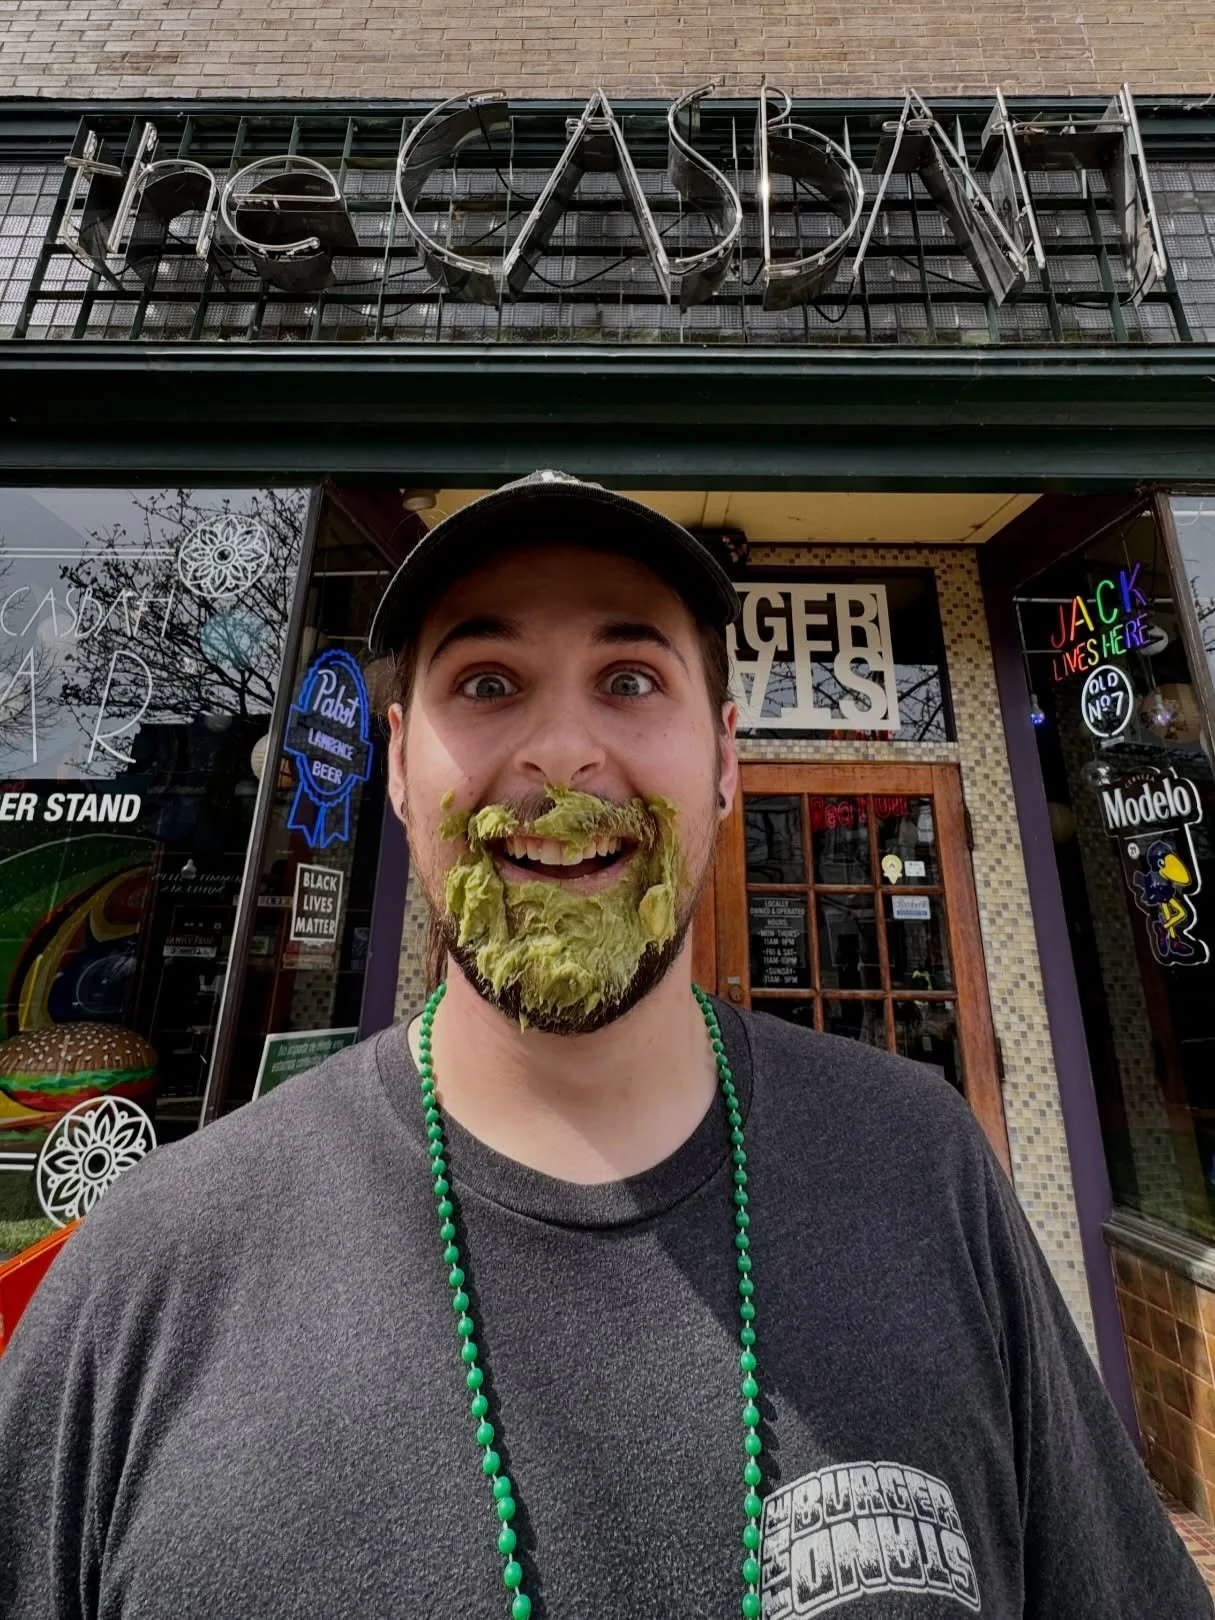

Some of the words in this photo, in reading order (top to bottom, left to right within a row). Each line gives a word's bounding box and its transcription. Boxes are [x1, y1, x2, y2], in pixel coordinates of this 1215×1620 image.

[63, 120, 348, 275] the
[1051, 562, 1147, 649] JACK
[1053, 637, 1100, 681] LIVES
[1102, 613, 1150, 659] HERE
[1088, 672, 1119, 694] OLD
[313, 669, 360, 729] Pabst
[311, 760, 343, 785] BEER
[1124, 773, 1156, 789] CERVEZA
[43, 792, 142, 822] STAND
[1102, 777, 1192, 830] Modelo
[303, 871, 338, 892] BLACK
[303, 893, 333, 913] LIVES
[295, 916, 336, 934] MATTER
[790, 1463, 963, 1540] BURGER
